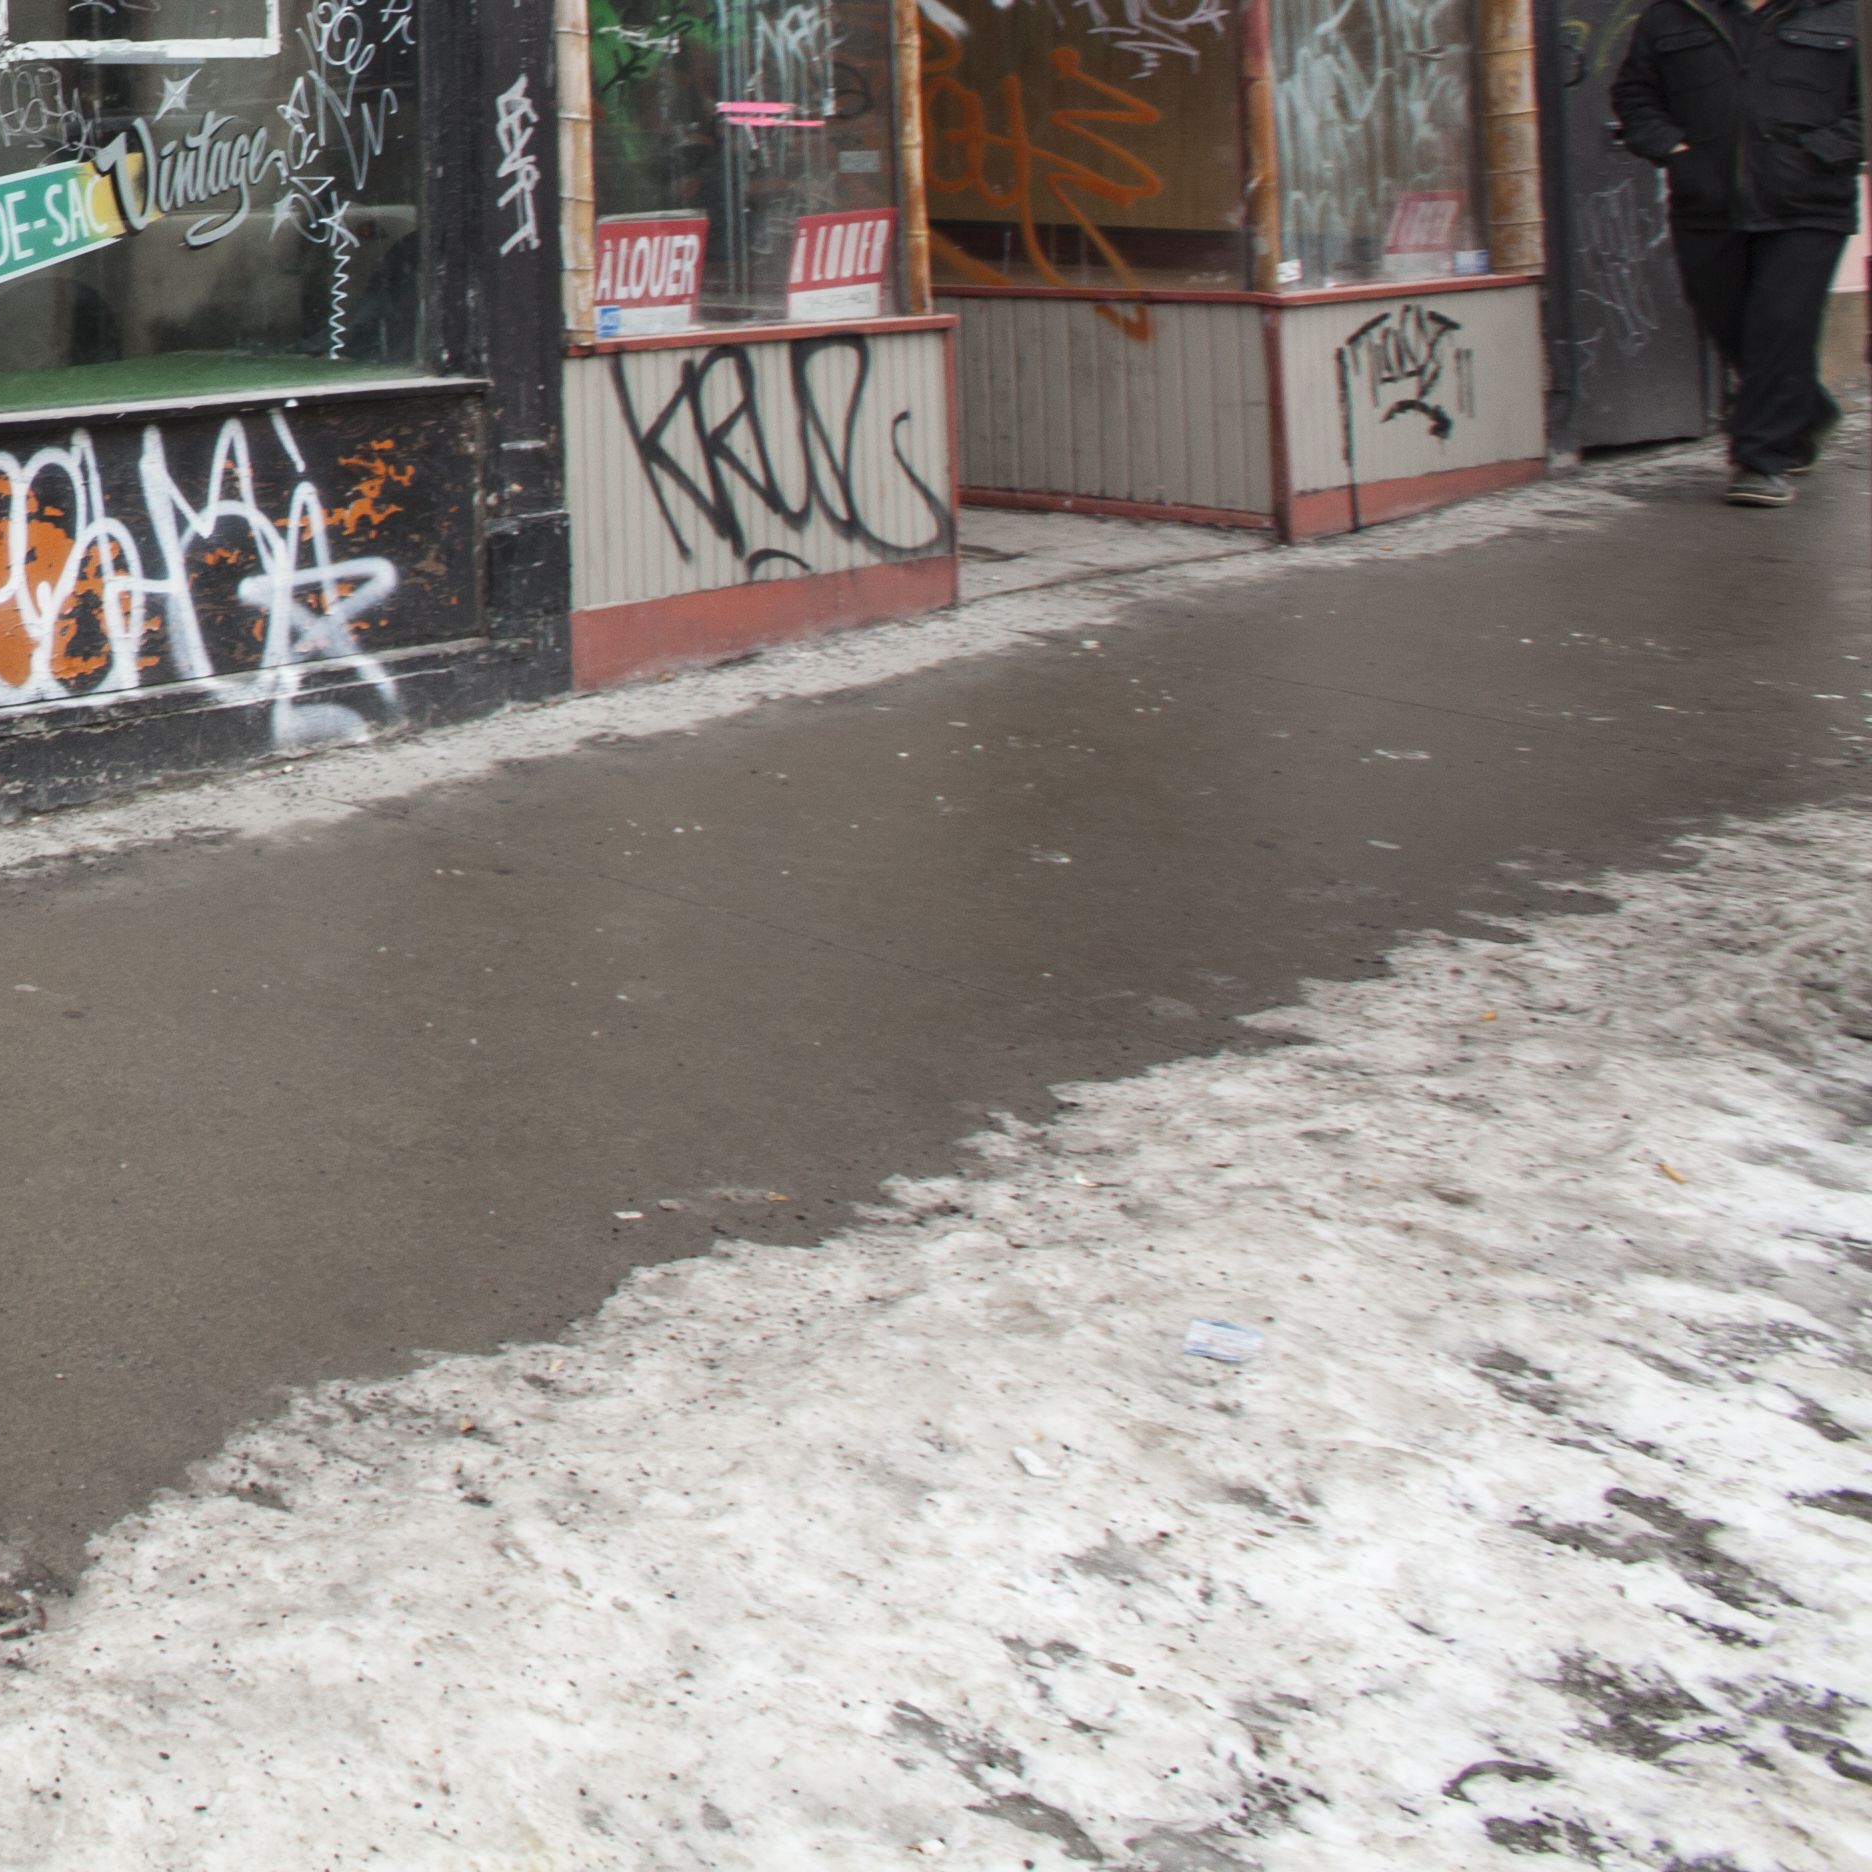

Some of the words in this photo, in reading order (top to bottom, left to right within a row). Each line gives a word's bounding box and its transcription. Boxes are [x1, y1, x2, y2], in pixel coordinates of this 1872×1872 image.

[95, 110, 288, 251] Vintage
[614, 234, 700, 300] LOUER
[811, 219, 890, 281] LOUER
